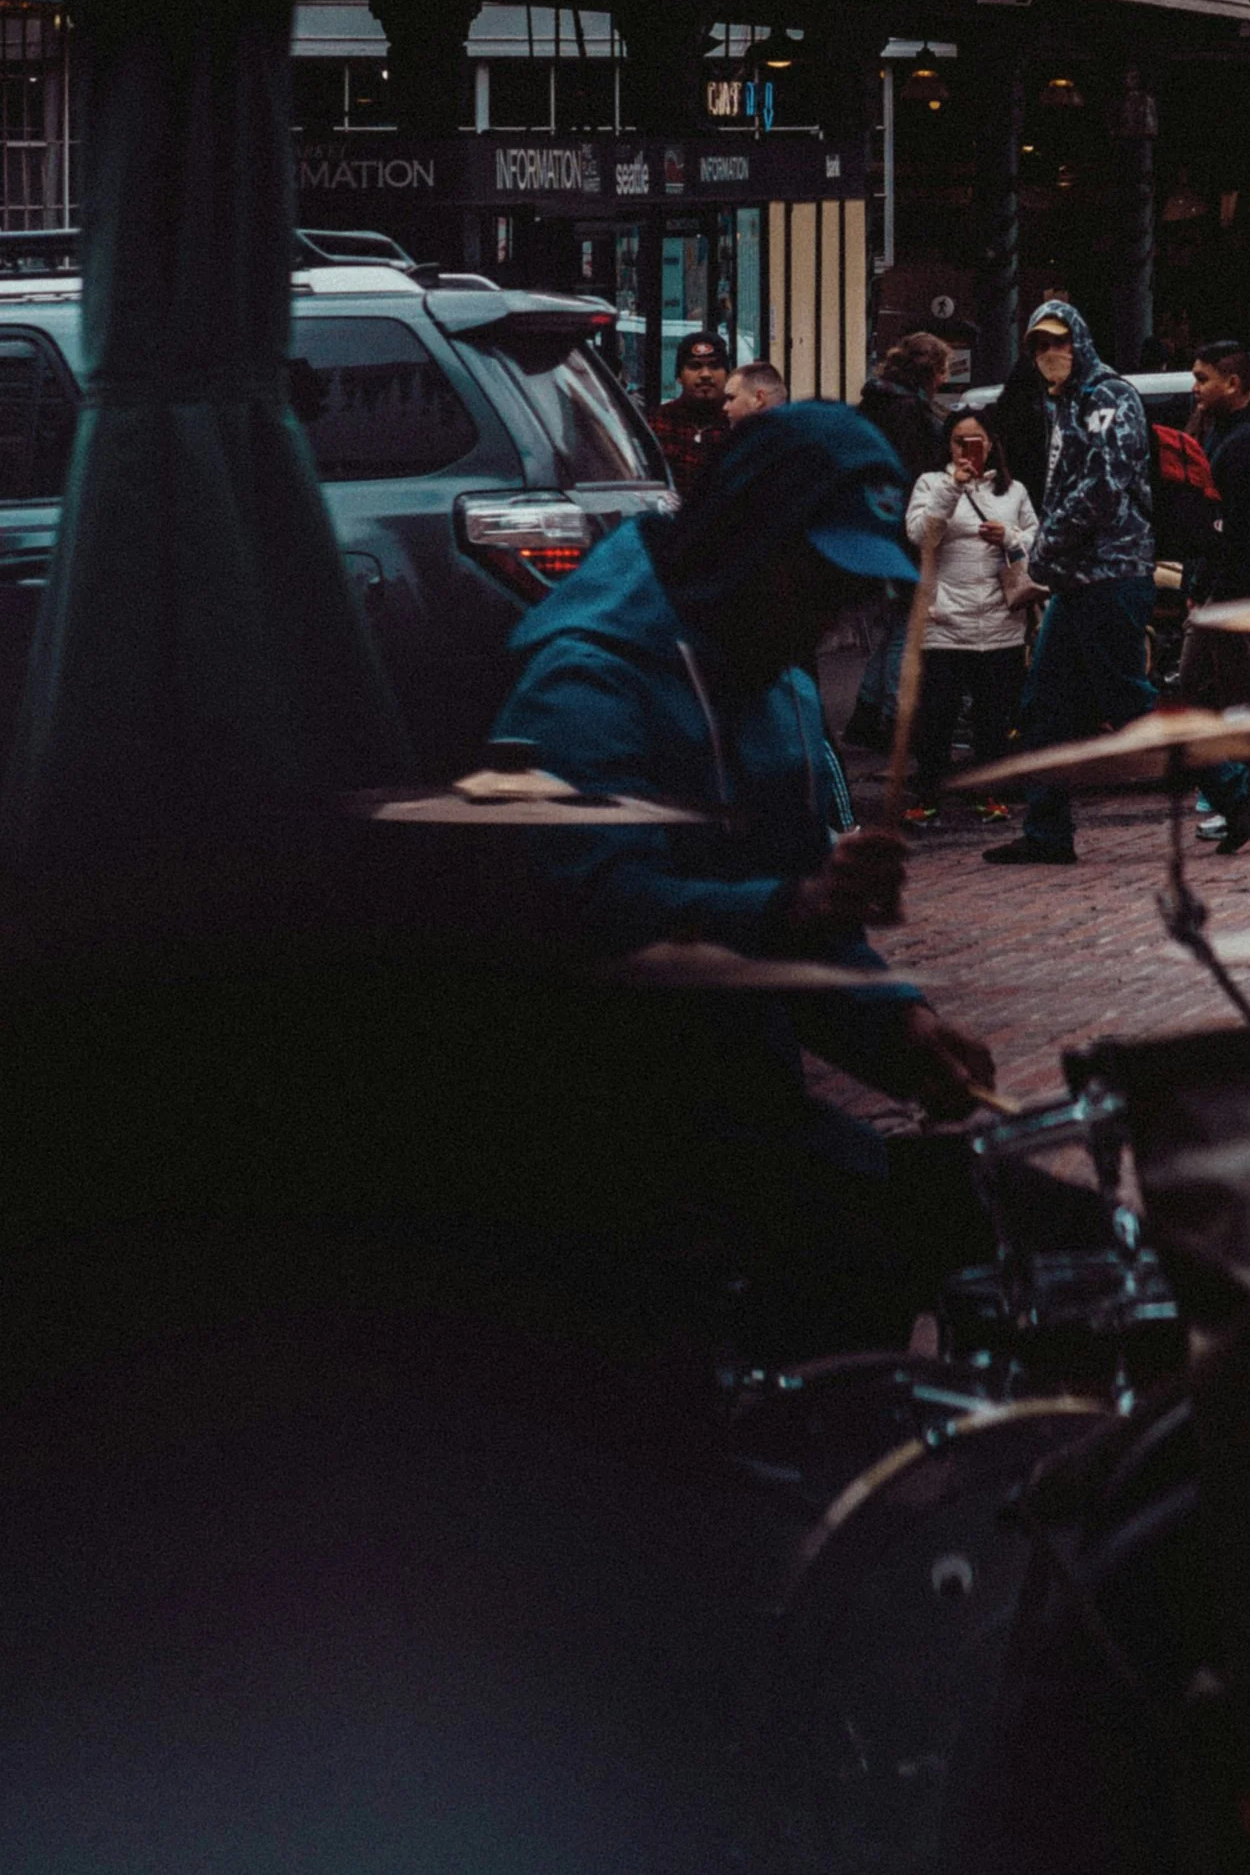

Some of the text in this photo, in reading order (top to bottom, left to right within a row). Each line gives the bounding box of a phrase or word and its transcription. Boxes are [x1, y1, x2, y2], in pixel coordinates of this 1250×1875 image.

[300, 160, 435, 189] MATION
[496, 148, 582, 190] INFORMATION
[616, 150, 650, 195] seattle
[700, 156, 749, 182] INFORMATION
